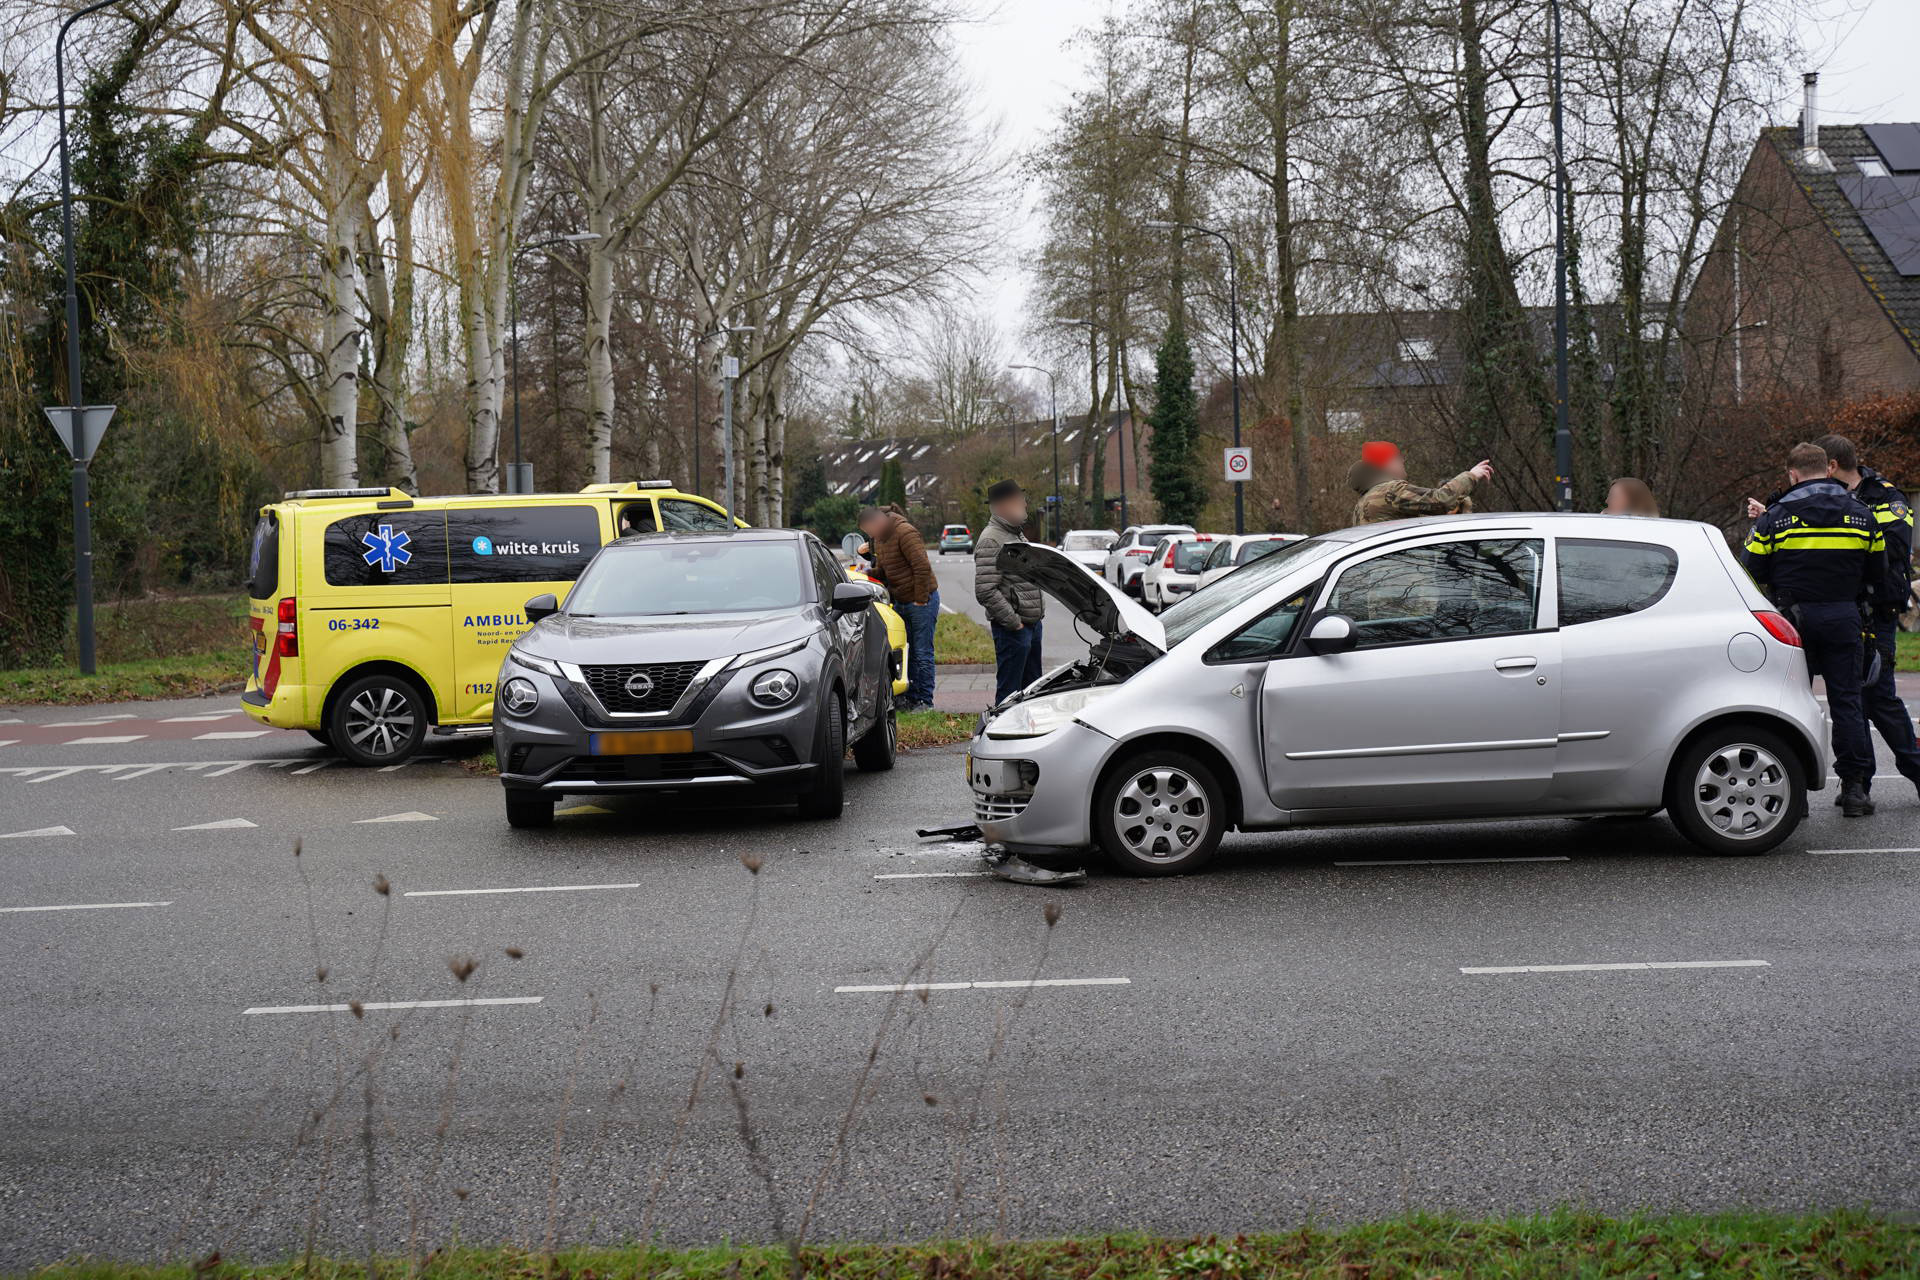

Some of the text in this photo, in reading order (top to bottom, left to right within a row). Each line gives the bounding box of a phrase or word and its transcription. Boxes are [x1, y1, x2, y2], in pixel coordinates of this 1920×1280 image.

[1232, 459, 1245, 468] 30
[496, 540, 580, 555] witte kruis
[328, 618, 380, 631] 06-342
[477, 638, 498, 646] Rapid
[624, 682, 655, 690] NISSAN
